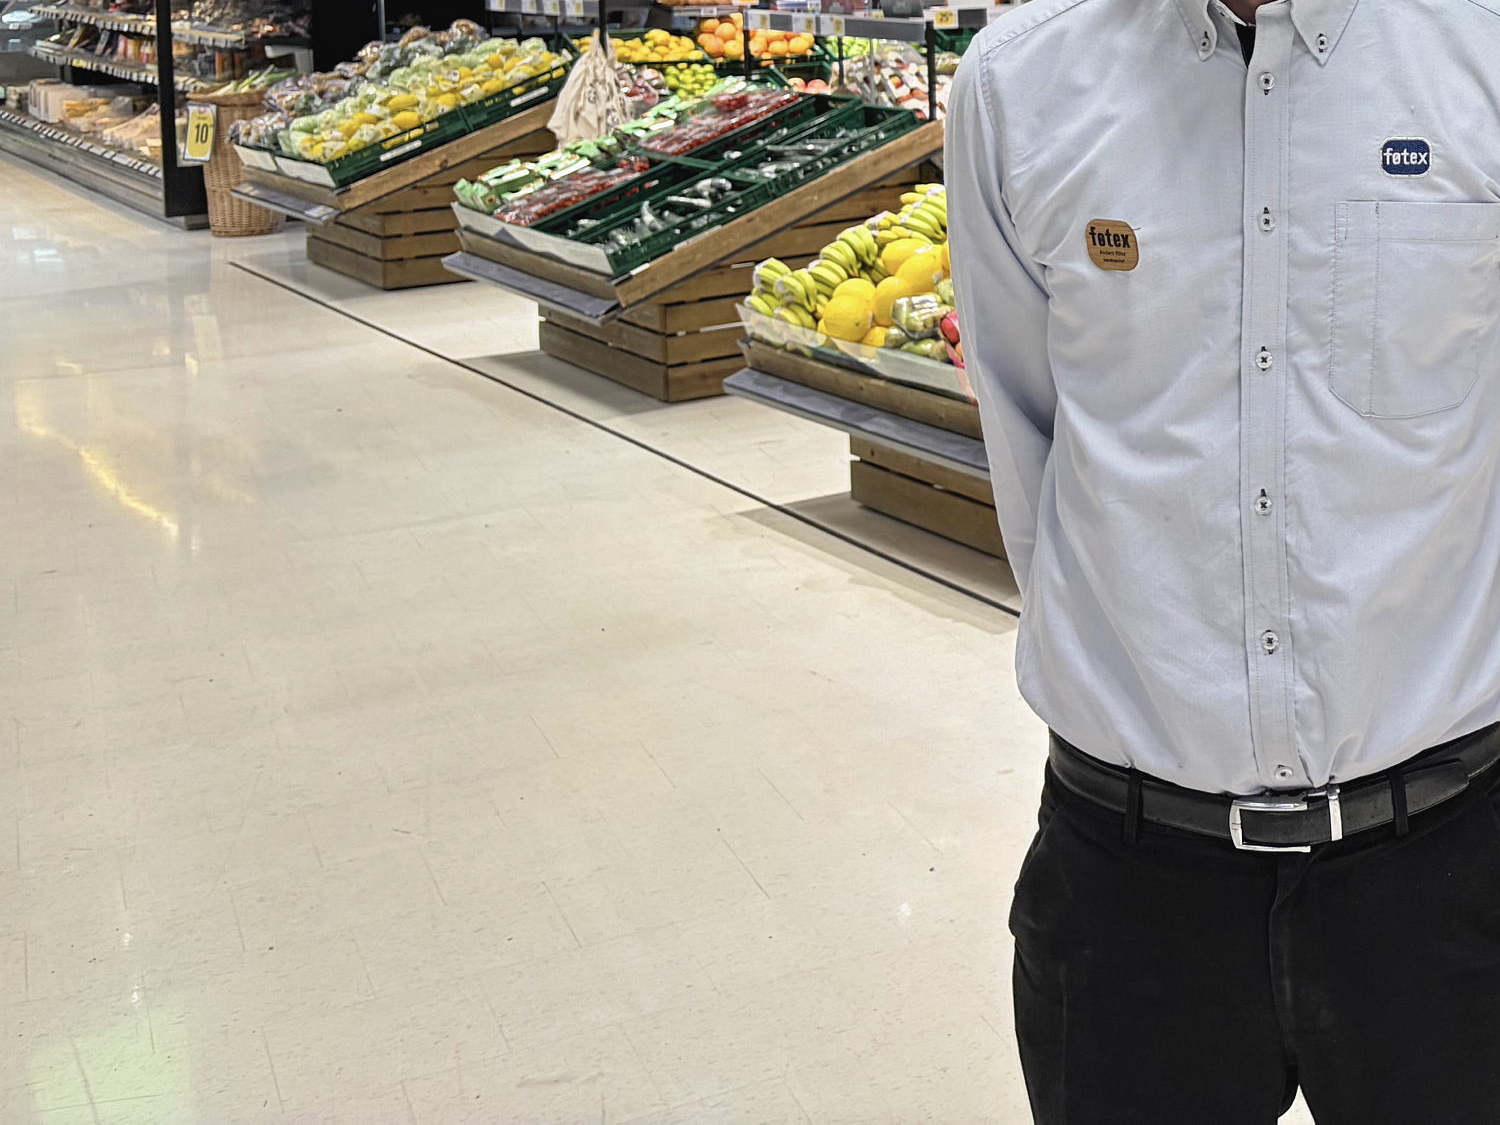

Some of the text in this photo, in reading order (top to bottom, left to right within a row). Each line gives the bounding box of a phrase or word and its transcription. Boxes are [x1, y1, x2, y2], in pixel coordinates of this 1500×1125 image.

[195, 123, 209, 143] 10
[1383, 147, 1429, 165] føtex
[1089, 226, 1131, 248] føtex
